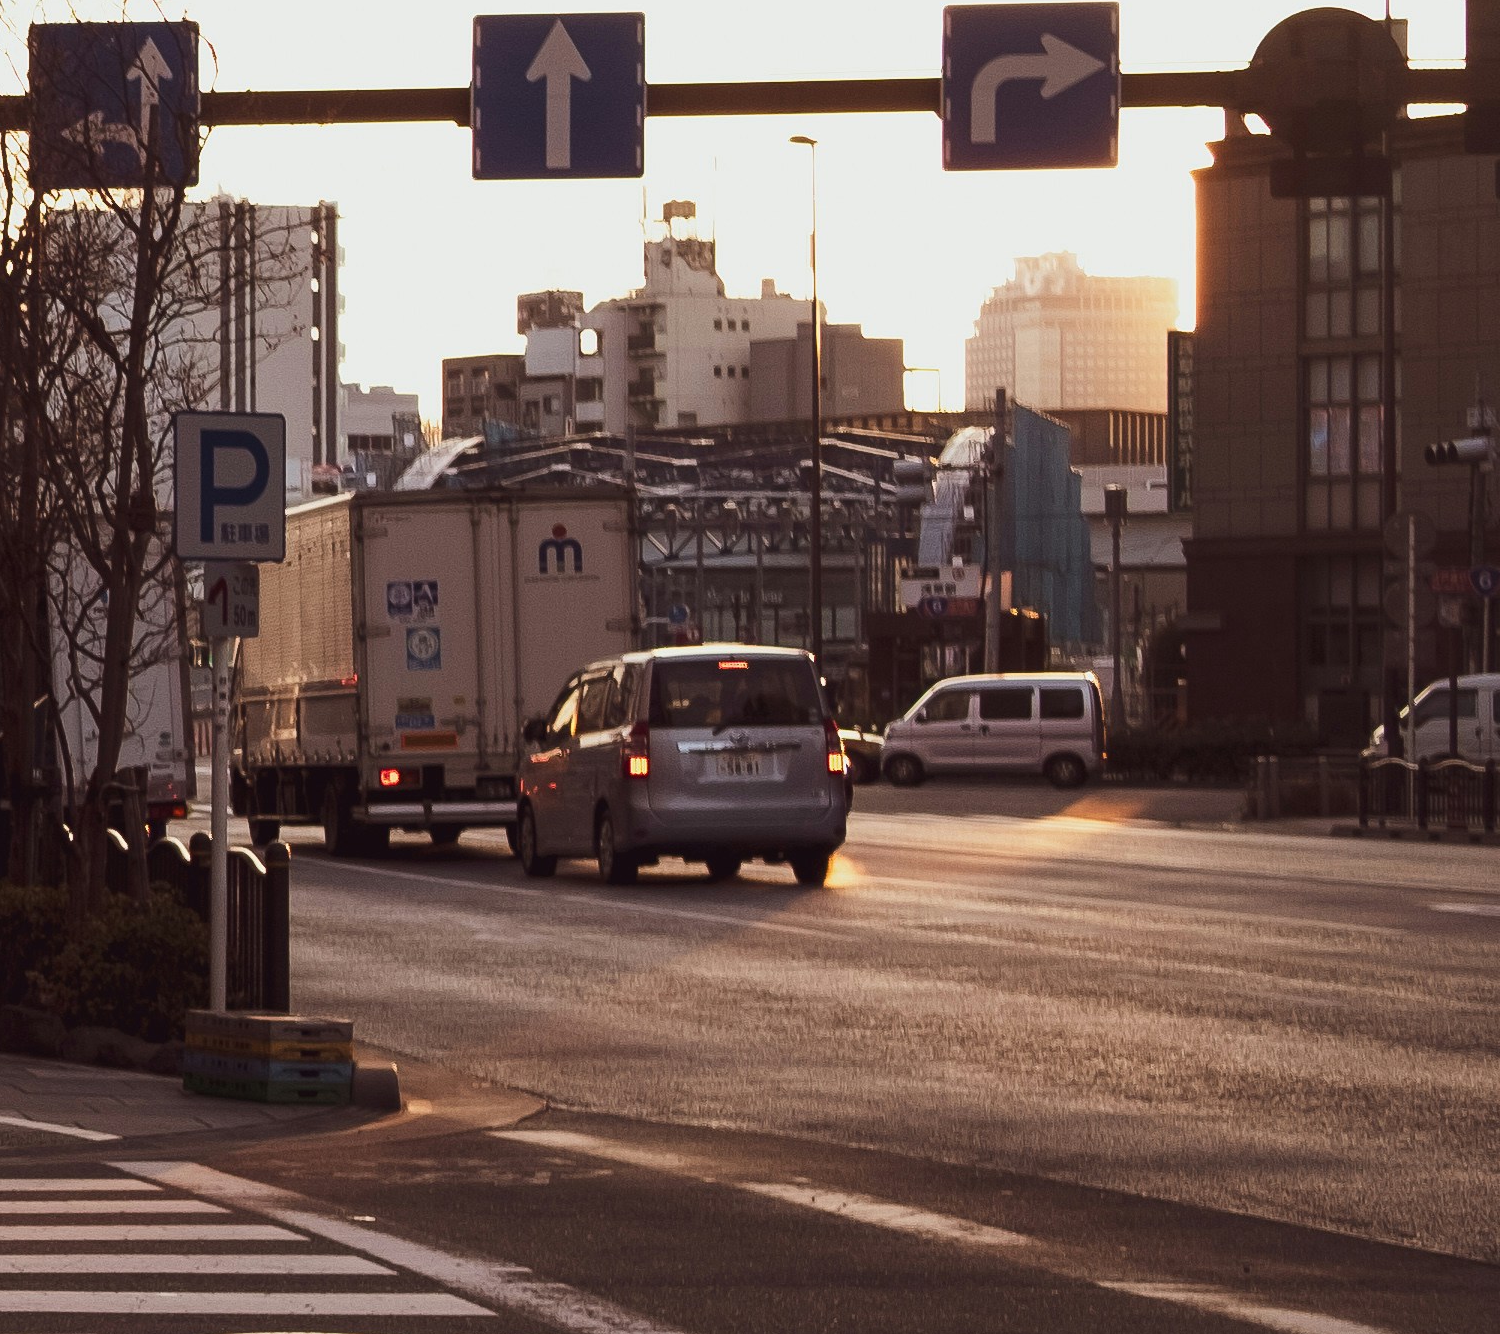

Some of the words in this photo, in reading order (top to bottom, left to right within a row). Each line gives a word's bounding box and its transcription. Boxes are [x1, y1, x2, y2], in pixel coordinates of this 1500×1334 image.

[200, 429, 270, 543] P
[220, 523, 269, 544] 駐車場
